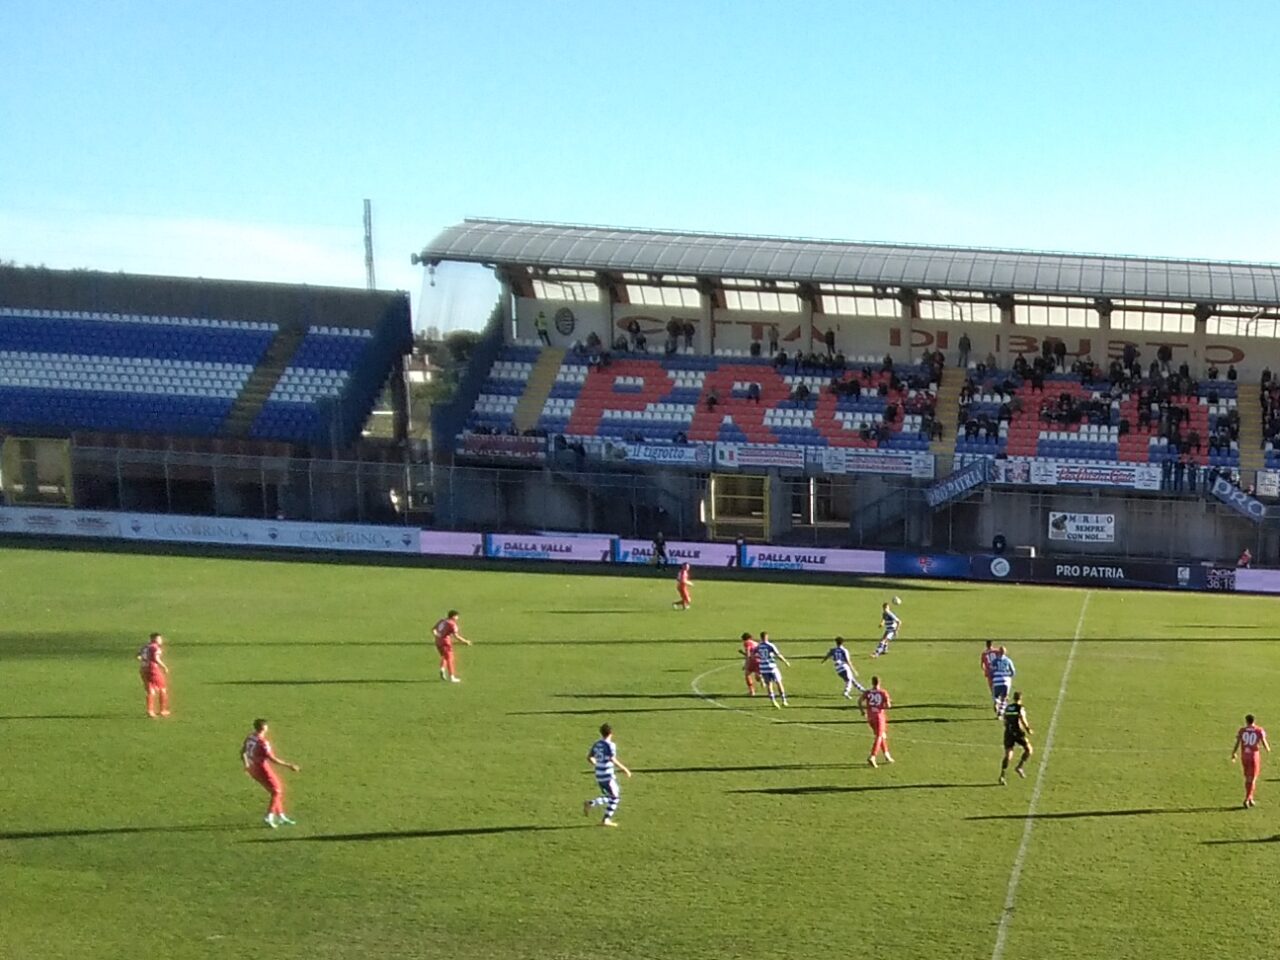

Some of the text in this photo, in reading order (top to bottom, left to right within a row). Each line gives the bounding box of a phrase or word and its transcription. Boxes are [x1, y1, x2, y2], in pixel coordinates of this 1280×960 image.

[889, 327, 948, 350] DI
[503, 541, 573, 553] DALLA VALLE
[631, 547, 701, 559] DAL VALLE
[758, 553, 827, 564] DALLA VALLE
[1056, 565, 1124, 579] PRO PATRIA
[867, 693, 882, 705] 29
[1242, 731, 1257, 746] 90
